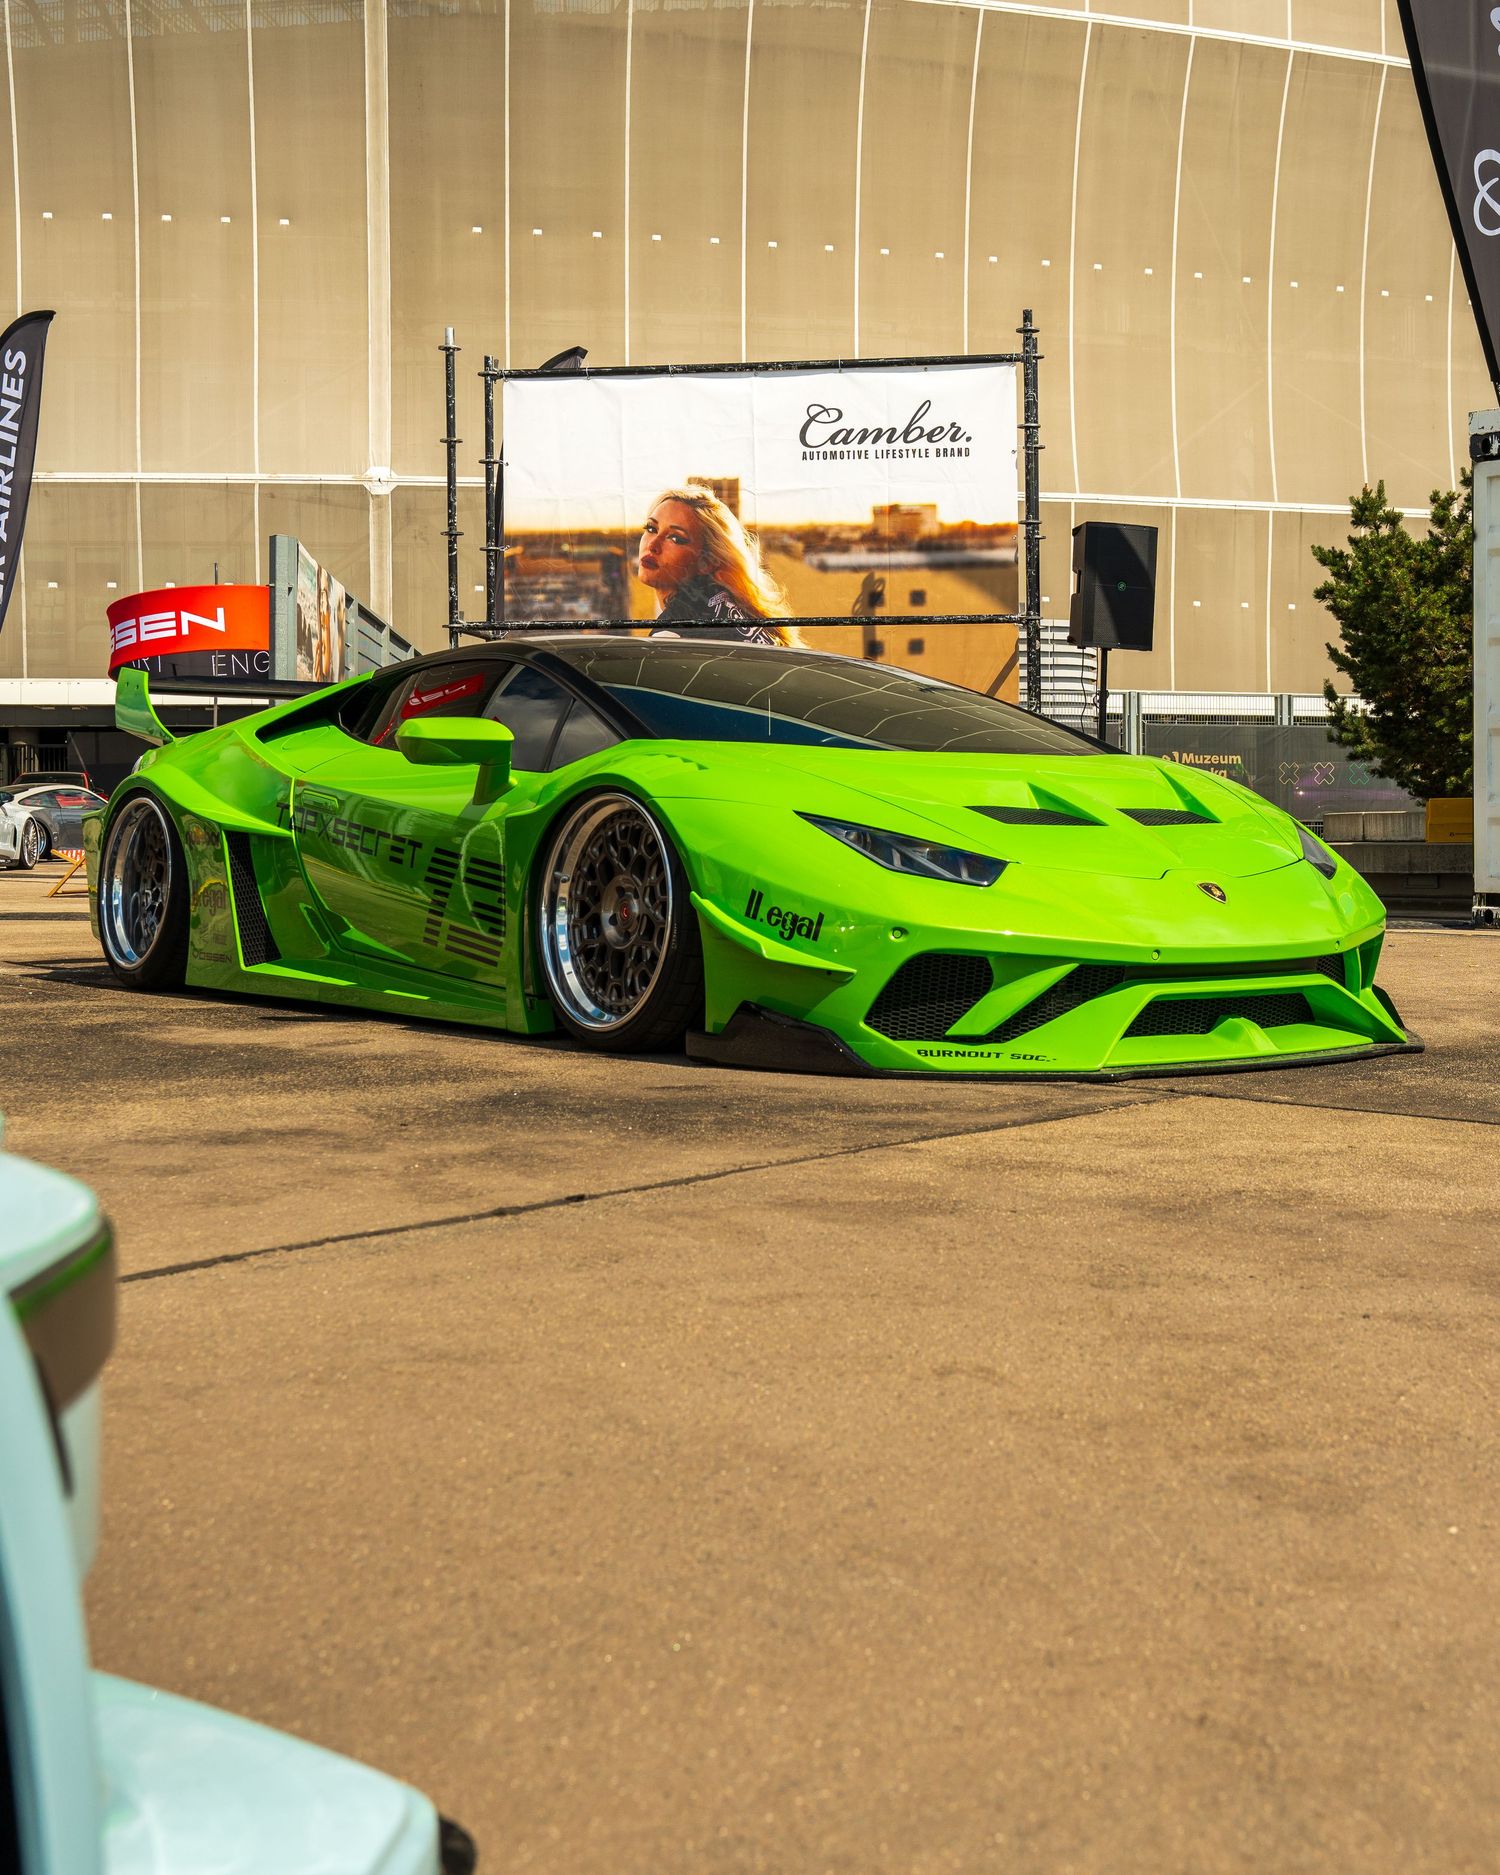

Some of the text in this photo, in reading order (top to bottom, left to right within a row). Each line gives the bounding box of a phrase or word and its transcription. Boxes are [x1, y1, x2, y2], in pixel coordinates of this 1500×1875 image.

[799, 399, 972, 449] Camber.
[802, 447, 970, 461] AUTOMOTIVE LIFESTYLE BRAND
[1181, 752, 1242, 765] Muzeum
[917, 1049, 1003, 1060] BURNOUT
